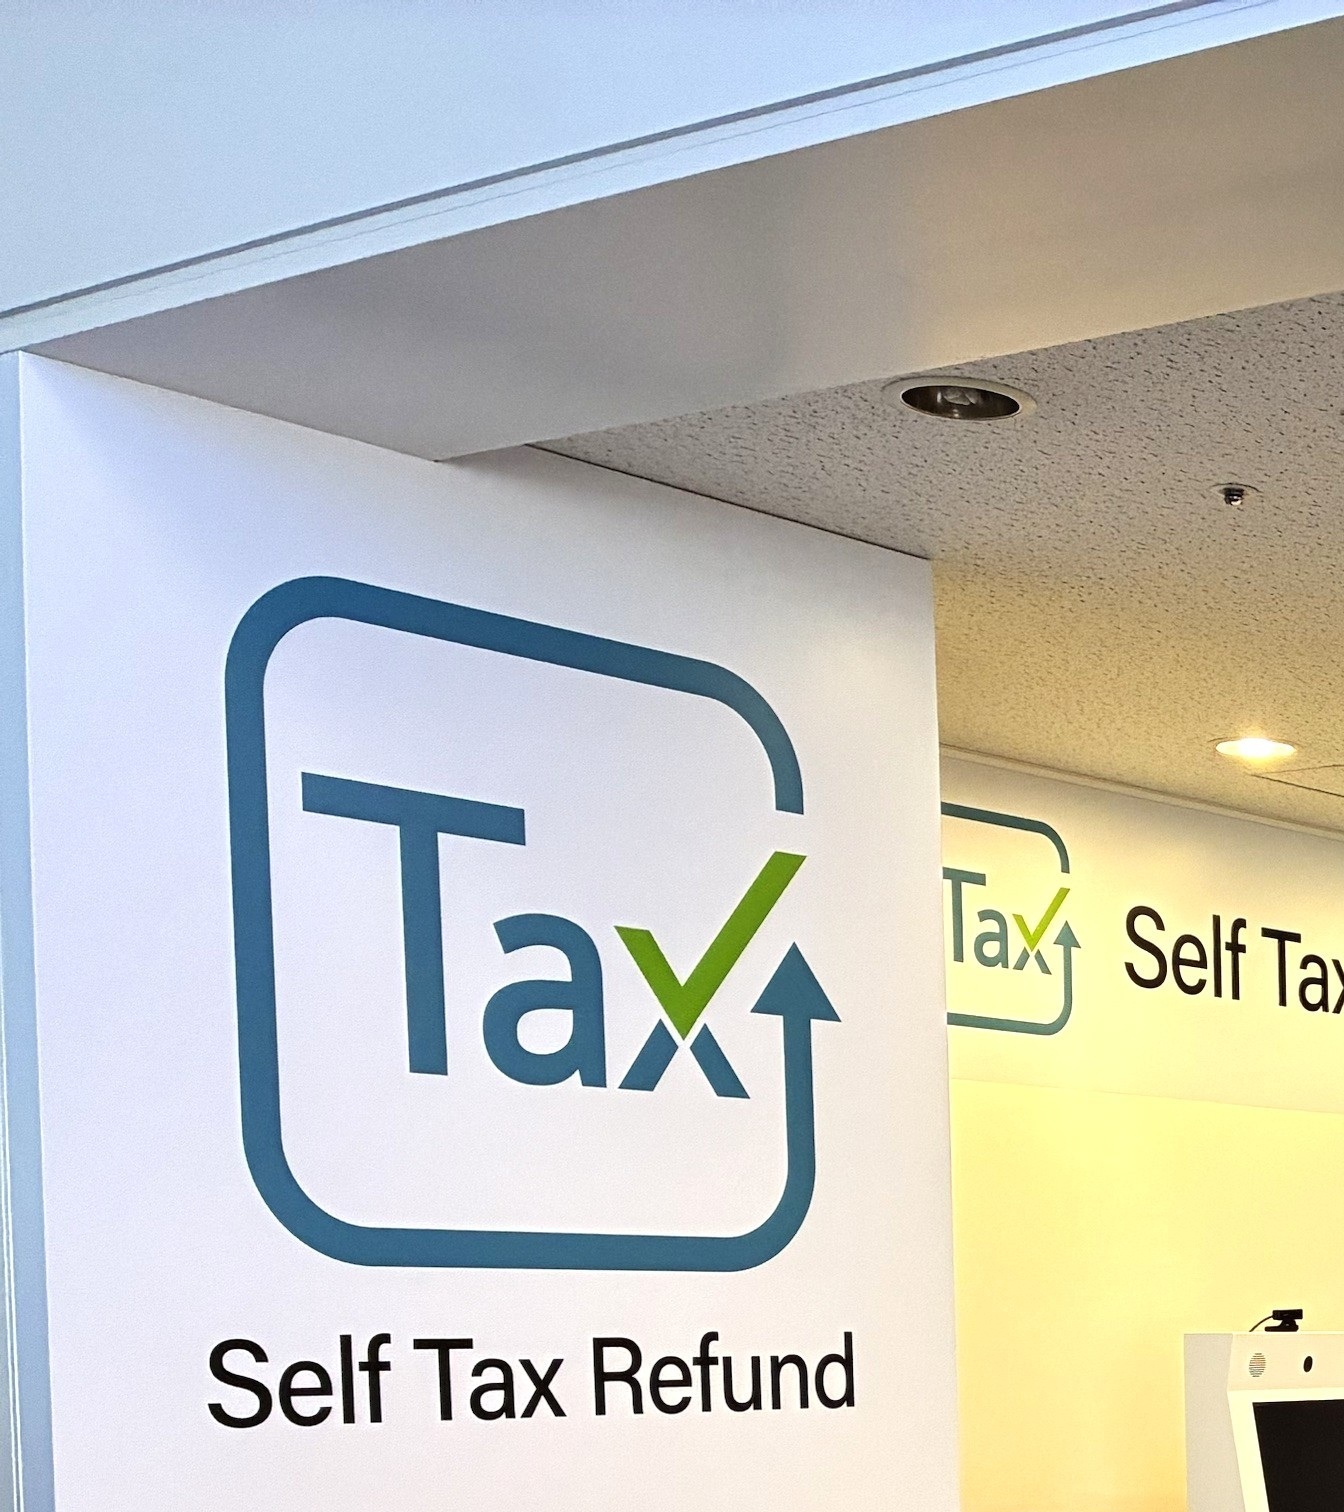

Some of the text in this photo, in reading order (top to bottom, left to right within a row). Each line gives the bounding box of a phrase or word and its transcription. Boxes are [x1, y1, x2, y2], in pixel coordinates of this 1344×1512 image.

[301, 771, 807, 1100] Tax
[942, 866, 1071, 976] Tax
[1124, 905, 1246, 1001] Self
[208, 1331, 857, 1429] Self Tax Refund
